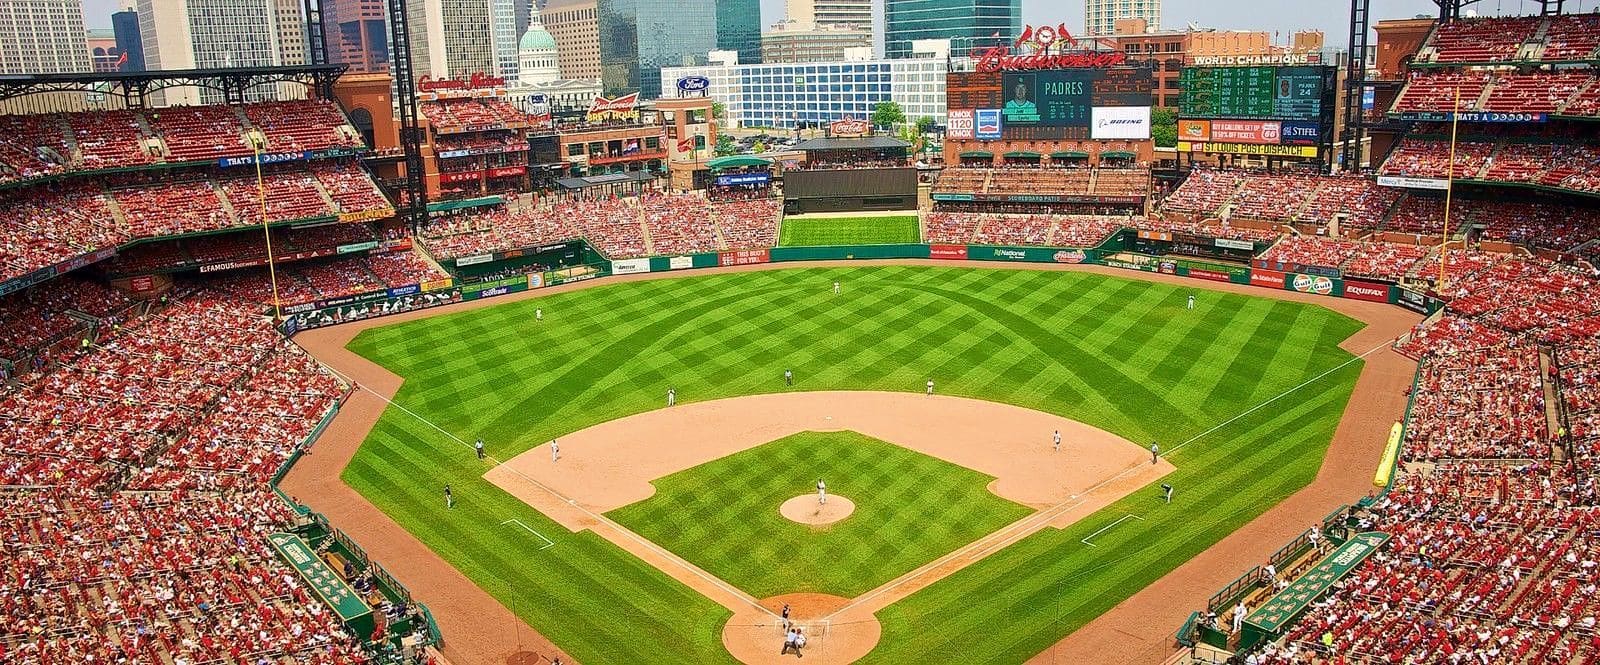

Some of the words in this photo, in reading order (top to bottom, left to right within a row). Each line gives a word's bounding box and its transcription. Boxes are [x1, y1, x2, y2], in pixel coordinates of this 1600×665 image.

[969, 46, 1126, 73] Budweiser
[1194, 56, 1235, 65] WORLD
[1237, 55, 1308, 64] CHAMPIONS
[685, 79, 705, 89] Ford
[1045, 82, 1083, 95] PADRES
[592, 97, 637, 111] Budweiser
[587, 112, 611, 121] BREW
[613, 109, 640, 120] HOUSE
[950, 119, 972, 128] 1120
[1264, 130, 1277, 138] 66
[1293, 127, 1317, 136] STIFEL
[1217, 144, 1239, 153] LOUIS
[227, 157, 251, 165] THAT'S
[206, 262, 235, 271] FAMOUS
[482, 287, 508, 298] Scottrade
[1346, 285, 1384, 297] EQUIFAX
